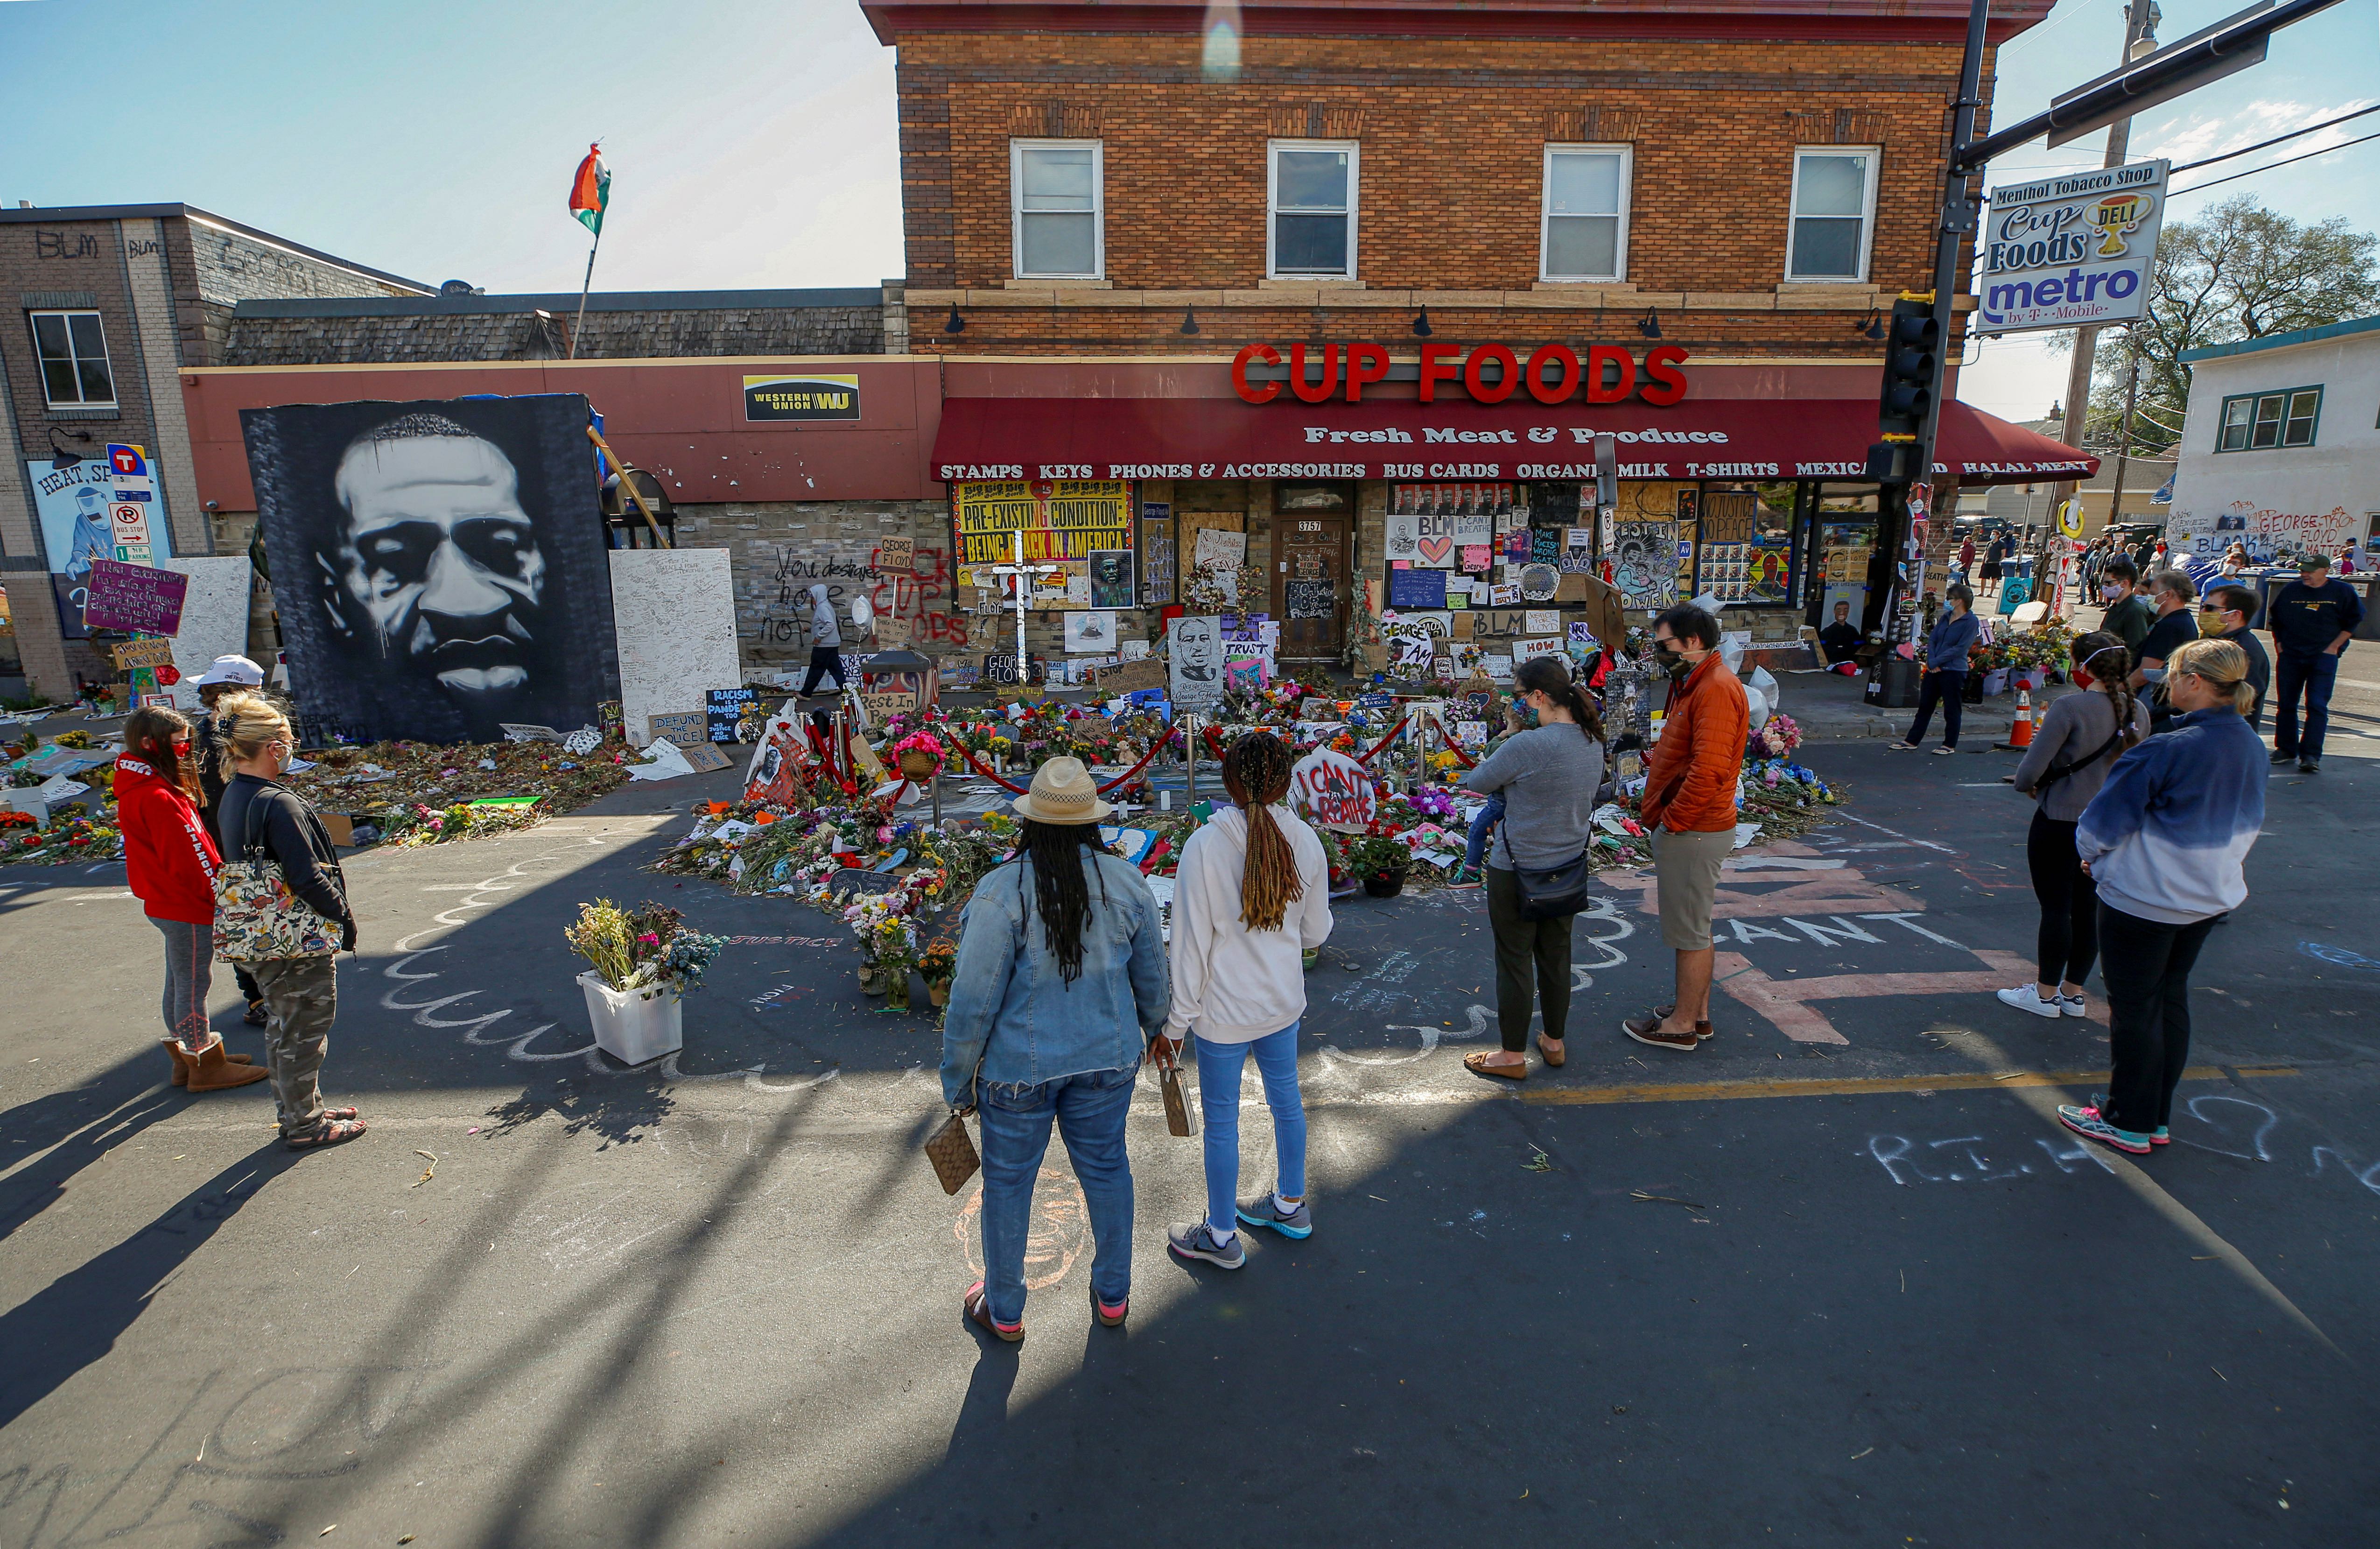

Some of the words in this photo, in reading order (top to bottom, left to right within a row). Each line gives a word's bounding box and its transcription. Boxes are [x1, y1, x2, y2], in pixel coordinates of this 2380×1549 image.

[1997, 186, 2049, 205] Menthol
[2055, 175, 2111, 193] Tobacco
[2117, 167, 2152, 185] Shop
[2099, 204, 2135, 226] DELI
[2000, 205, 2082, 241] Cup
[36, 231, 98, 259] BLM
[128, 239, 158, 259] BLM
[1987, 232, 2084, 271] Foods
[1988, 268, 2138, 310] metro
[2008, 312, 2025, 326] by
[1232, 343, 1390, 404] CUP
[1419, 343, 1690, 406] FOODS
[754, 393, 810, 402] WESTERN
[815, 393, 849, 409] WU
[1303, 427, 1414, 443] Fresh
[1422, 427, 1518, 443] Meat
[1527, 427, 1558, 443] &
[941, 465, 1023, 479] STAMPS
[1039, 464, 1093, 479] KEYS
[1109, 464, 1193, 478] PHONES
[1199, 464, 1215, 478] &
[1222, 463, 1366, 478] ACCESSORIES
[1383, 463, 1424, 477] BUS
[1429, 463, 1499, 477] CARDS
[1517, 463, 1597, 478] ORGANI
[1617, 463, 1669, 477] MILK
[1686, 463, 1780, 476] T-SHIRTS
[1964, 462, 2032, 474] HALAL
[2033, 461, 2089, 472] MEAT
[1704, 496, 1716, 518] NO
[1717, 494, 1754, 517] JUSTICE
[964, 501, 1047, 531] PRE-EXISTING
[1052, 500, 1123, 527] CONDITION:
[1299, 522, 1320, 530] 3757
[1418, 516, 1455, 536] BLM
[1458, 525, 1490, 534] BREATHE
[1703, 518, 1715, 540] NO
[1716, 519, 1754, 540] PEACE
[1201, 531, 1213, 541] No
[1535, 529, 1554, 540] MAKE
[1654, 522, 1680, 550] IN
[2301, 529, 2337, 542] FLOYD
[882, 540, 912, 554] GEORGE
[967, 534, 1004, 562] BEING
[1008, 532, 1046, 560] BACK
[1051, 533, 1063, 558] IN
[1067, 531, 1123, 558] AMERICA
[1199, 541, 1211, 554] No
[1535, 538, 1560, 548] RACISM
[119, 549, 125, 559] 1
[1533, 547, 1558, 557] WRONG
[775, 547, 818, 582] You
[883, 554, 911, 568] FLOYD
[1464, 561, 1485, 571] George
[1532, 555, 1558, 565] AGAIN
[103, 563, 125, 575] Not
[872, 582, 942, 617] CUP
[1621, 577, 1677, 611] OWER
[979, 601, 1003, 613] FLOYD
[1477, 612, 1524, 635] BLM
[1528, 623, 1558, 632] FLOYD
[1572, 623, 1584, 634] NO
[1225, 644, 1268, 654] TRUST
[1527, 640, 1554, 652] HOW
[958, 659, 973, 668] WE
[1099, 665, 1124, 677] STOP
[714, 689, 753, 701] RACISM
[1026, 687, 1043, 696] Floyd
[1172, 691, 1197, 702] George
[1198, 691, 1223, 700] Floyd
[707, 701, 758, 715] PANDEC
[896, 695, 914, 708] In
[653, 715, 704, 729] DEFUND
[304, 941, 326, 952] Peace
[729, 935, 844, 947] JUSTICE
